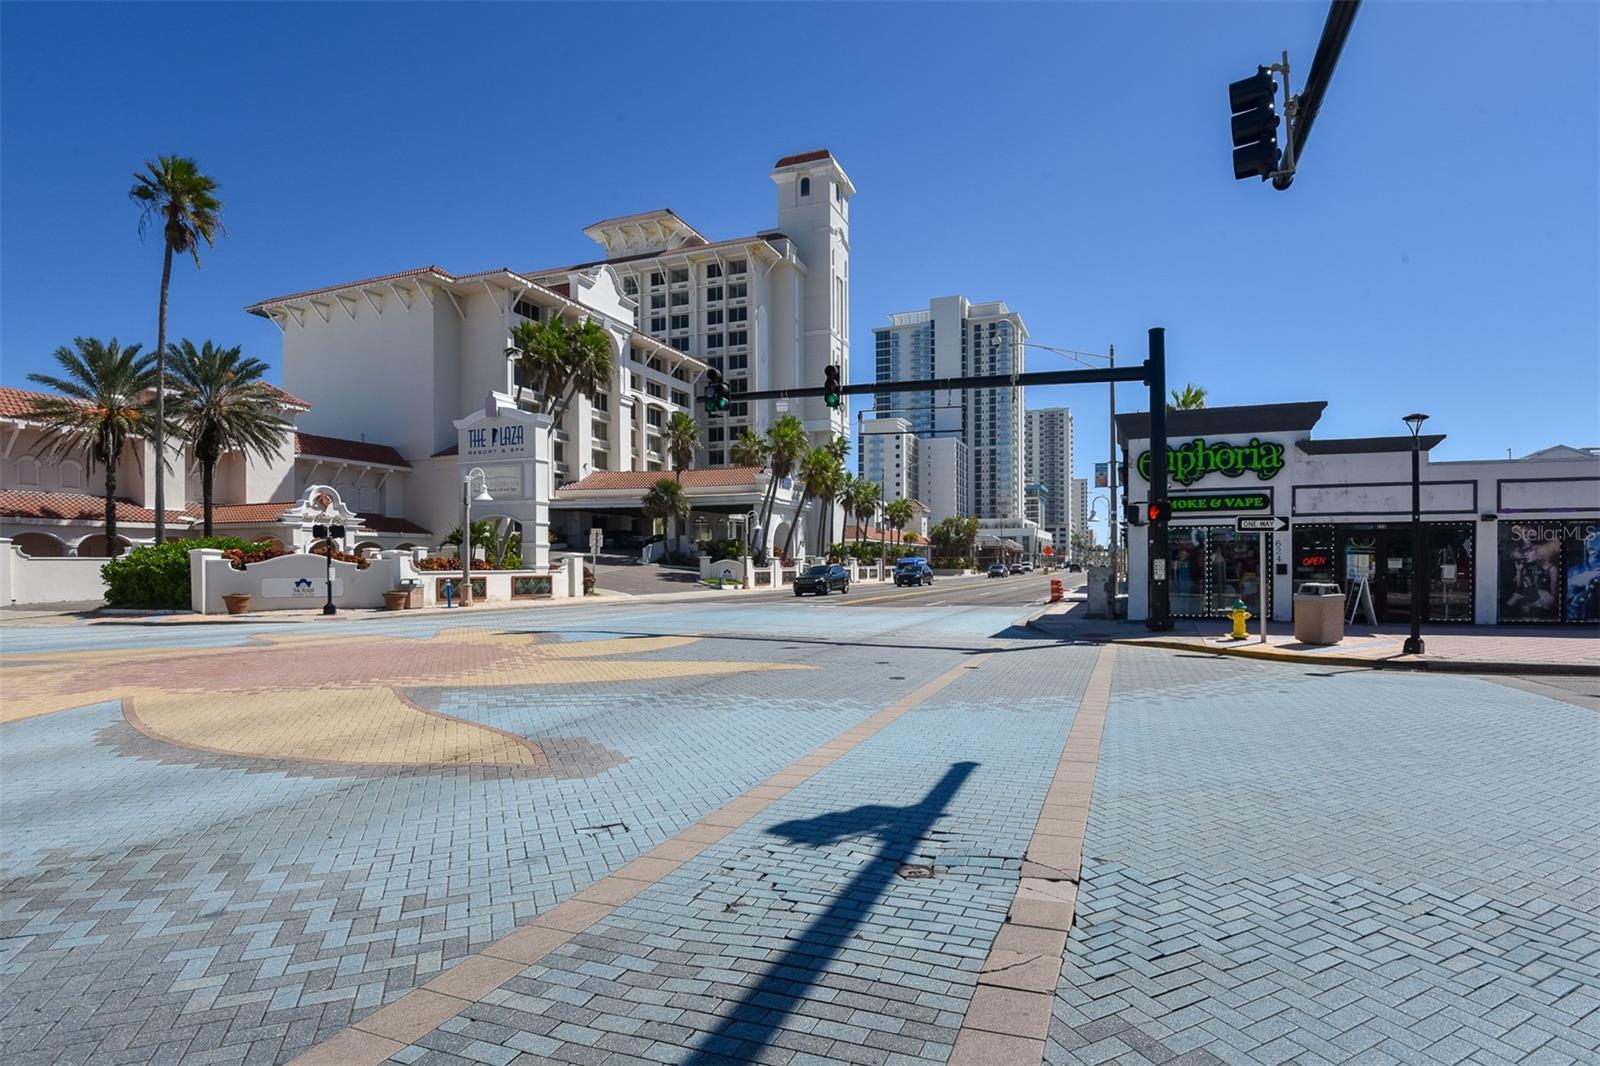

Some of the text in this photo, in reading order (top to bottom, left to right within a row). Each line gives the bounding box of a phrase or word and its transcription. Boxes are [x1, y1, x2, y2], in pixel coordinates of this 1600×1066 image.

[468, 425, 524, 448] THE PLAZA
[1170, 497, 1264, 510] MOKE & VAPE
[1243, 519, 1275, 528] ONE WAY
[1302, 556, 1327, 567] OPEN
